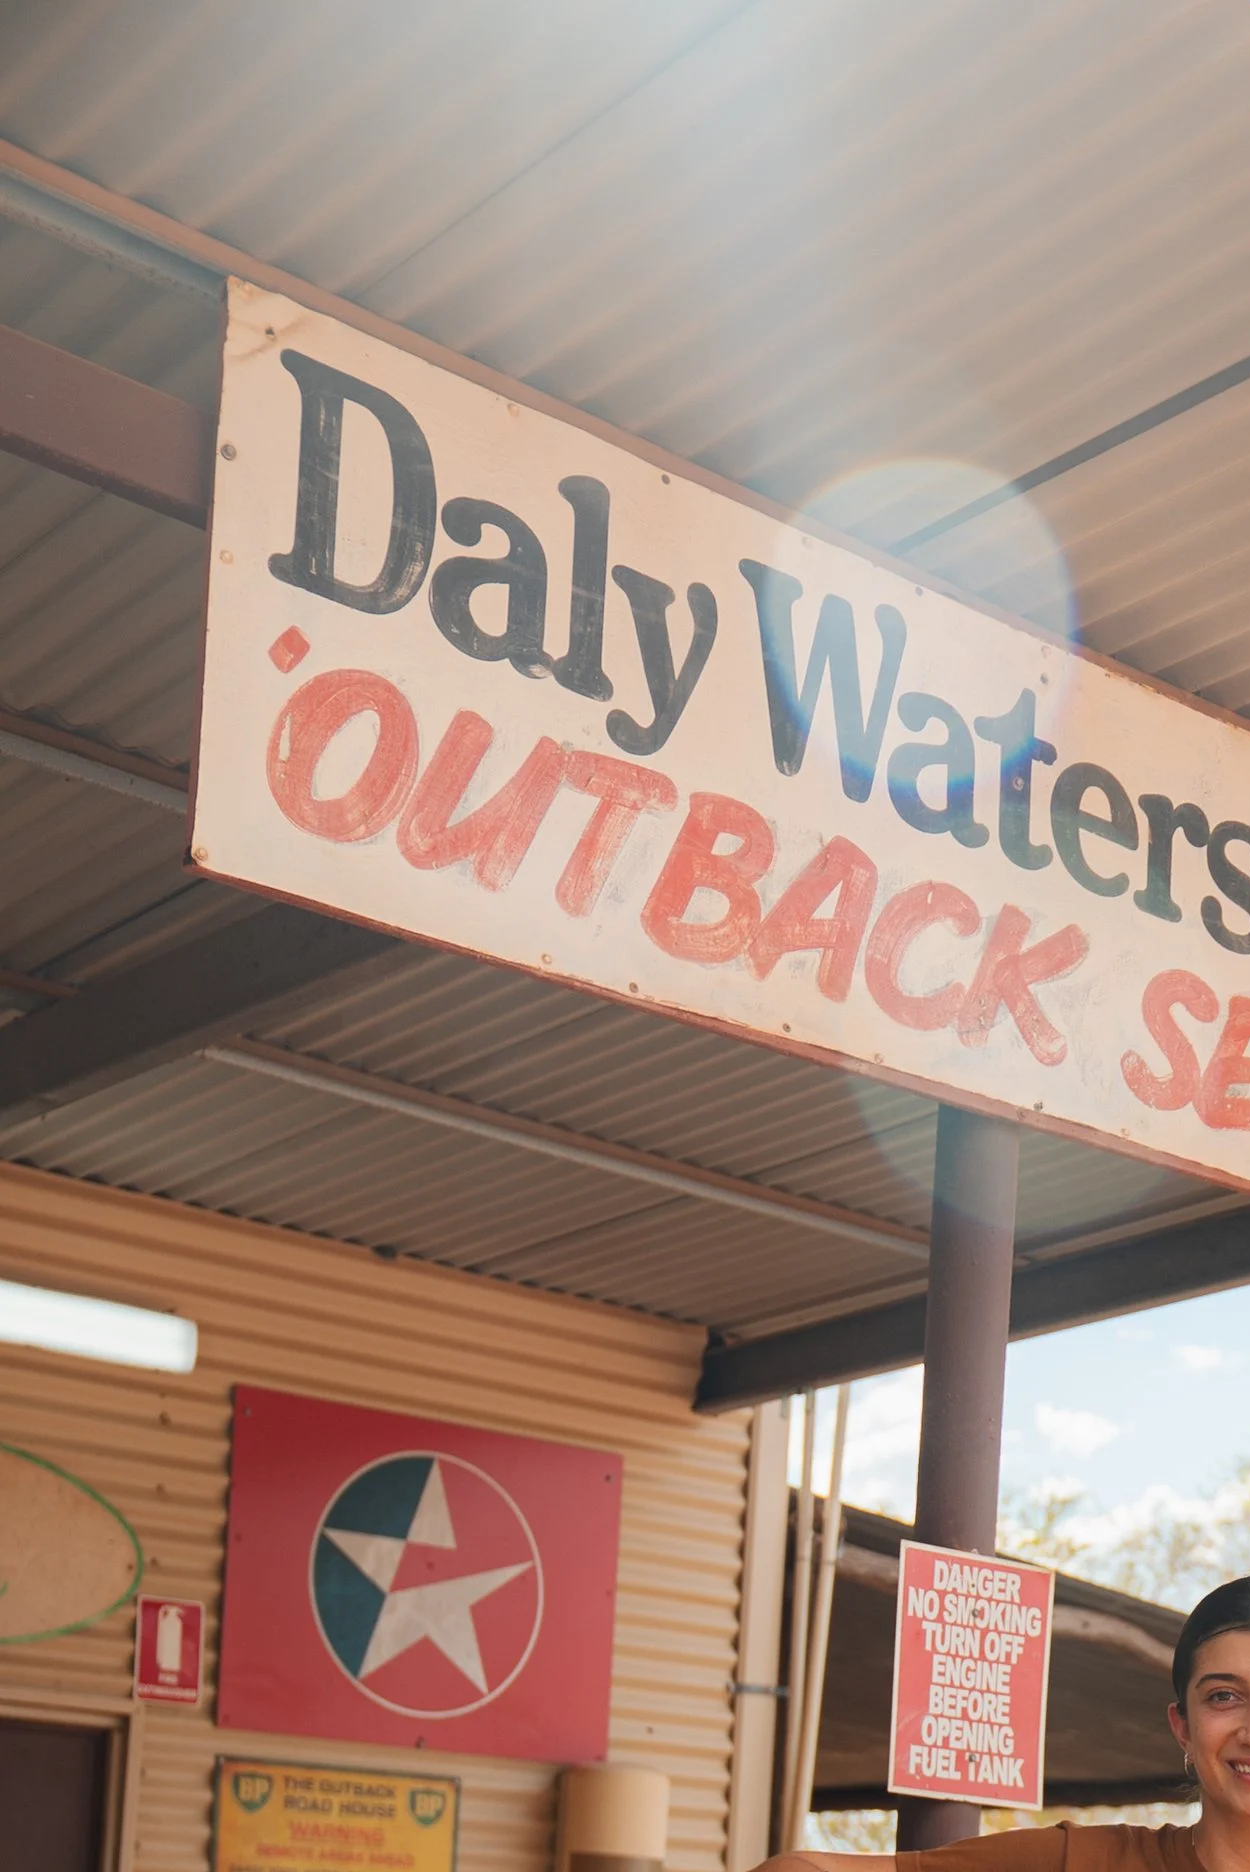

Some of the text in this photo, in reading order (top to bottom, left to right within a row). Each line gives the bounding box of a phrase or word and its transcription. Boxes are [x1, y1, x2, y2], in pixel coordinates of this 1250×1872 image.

[267, 349, 718, 756] Daly
[933, 1560, 1021, 1603] DANGER
[907, 1586, 1042, 1637] NO SMOKING
[922, 1621, 1025, 1664] TURN OFF
[931, 1654, 1011, 1693] ENGINE
[929, 1685, 1010, 1724] BEFORE
[921, 1717, 1014, 1755] OPENING
[908, 1744, 1024, 1788] FUEL TANK
[239, 1775, 271, 1800] BP
[283, 1776, 397, 1797] THE OUTBACK
[415, 1792, 446, 1816] BP
[283, 1795, 397, 1818] ROAD HOUSE
[290, 1821, 385, 1847] WARNING
